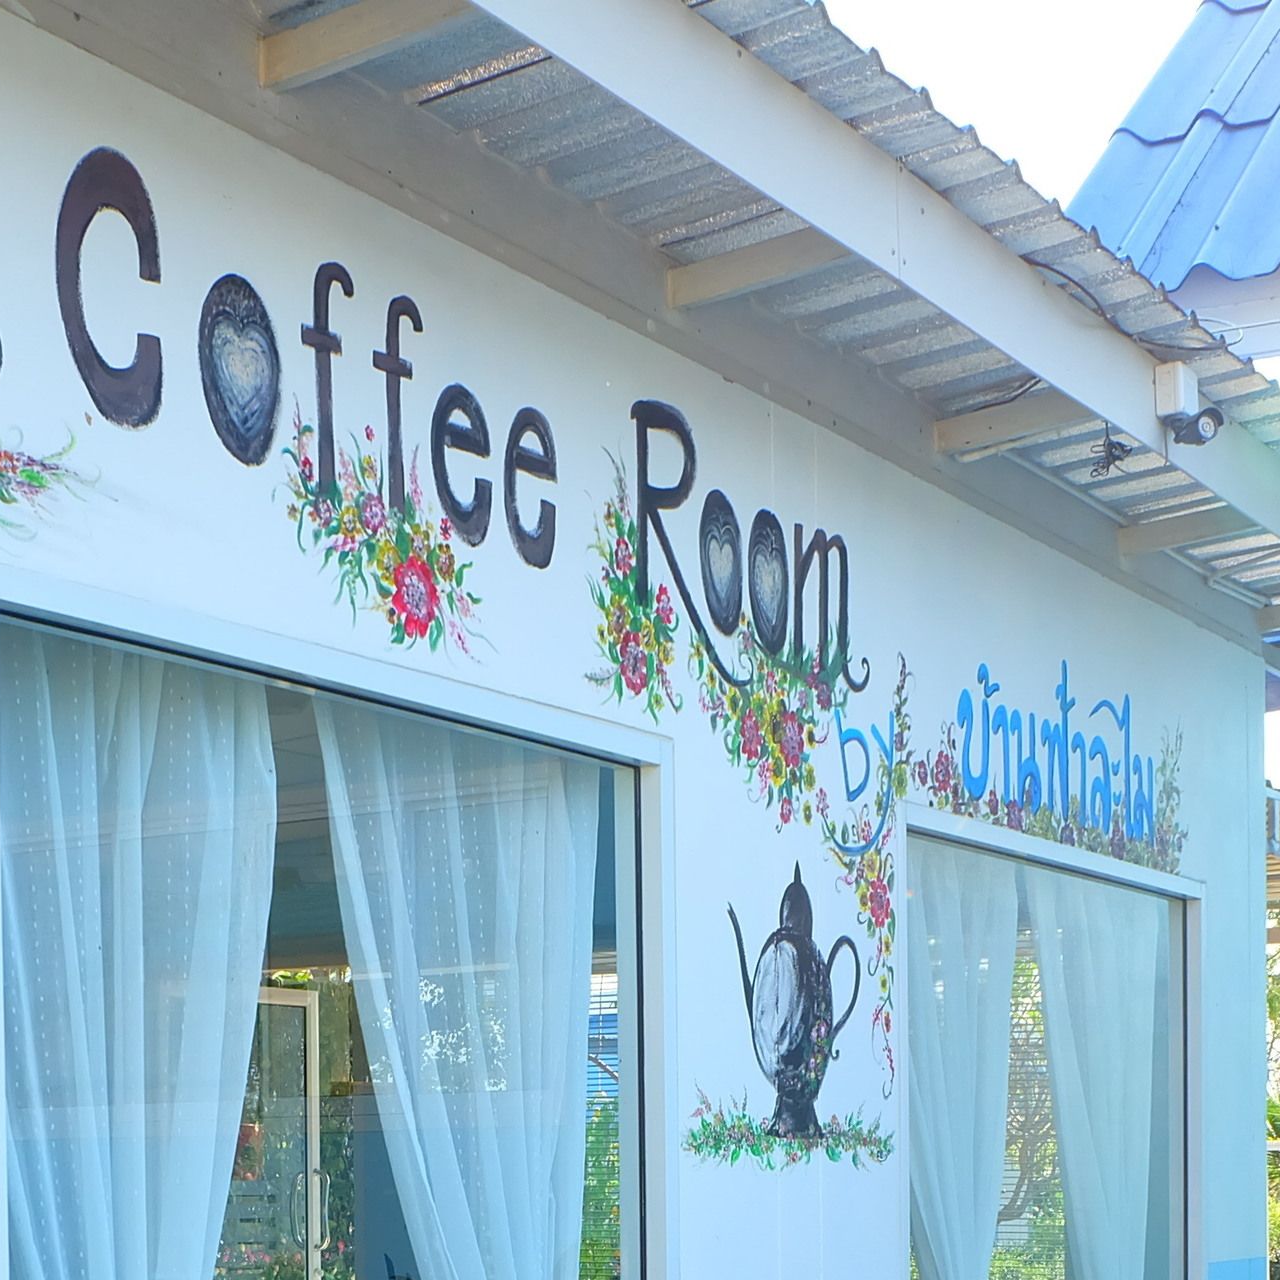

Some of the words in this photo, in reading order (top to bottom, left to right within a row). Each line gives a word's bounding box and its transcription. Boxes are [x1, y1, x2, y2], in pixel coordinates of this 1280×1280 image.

[55, 146, 559, 569] Coffee
[629, 399, 871, 693] Room
[822, 708, 896, 857] by
[957, 659, 1154, 846] บ้านฟ้าละไม
